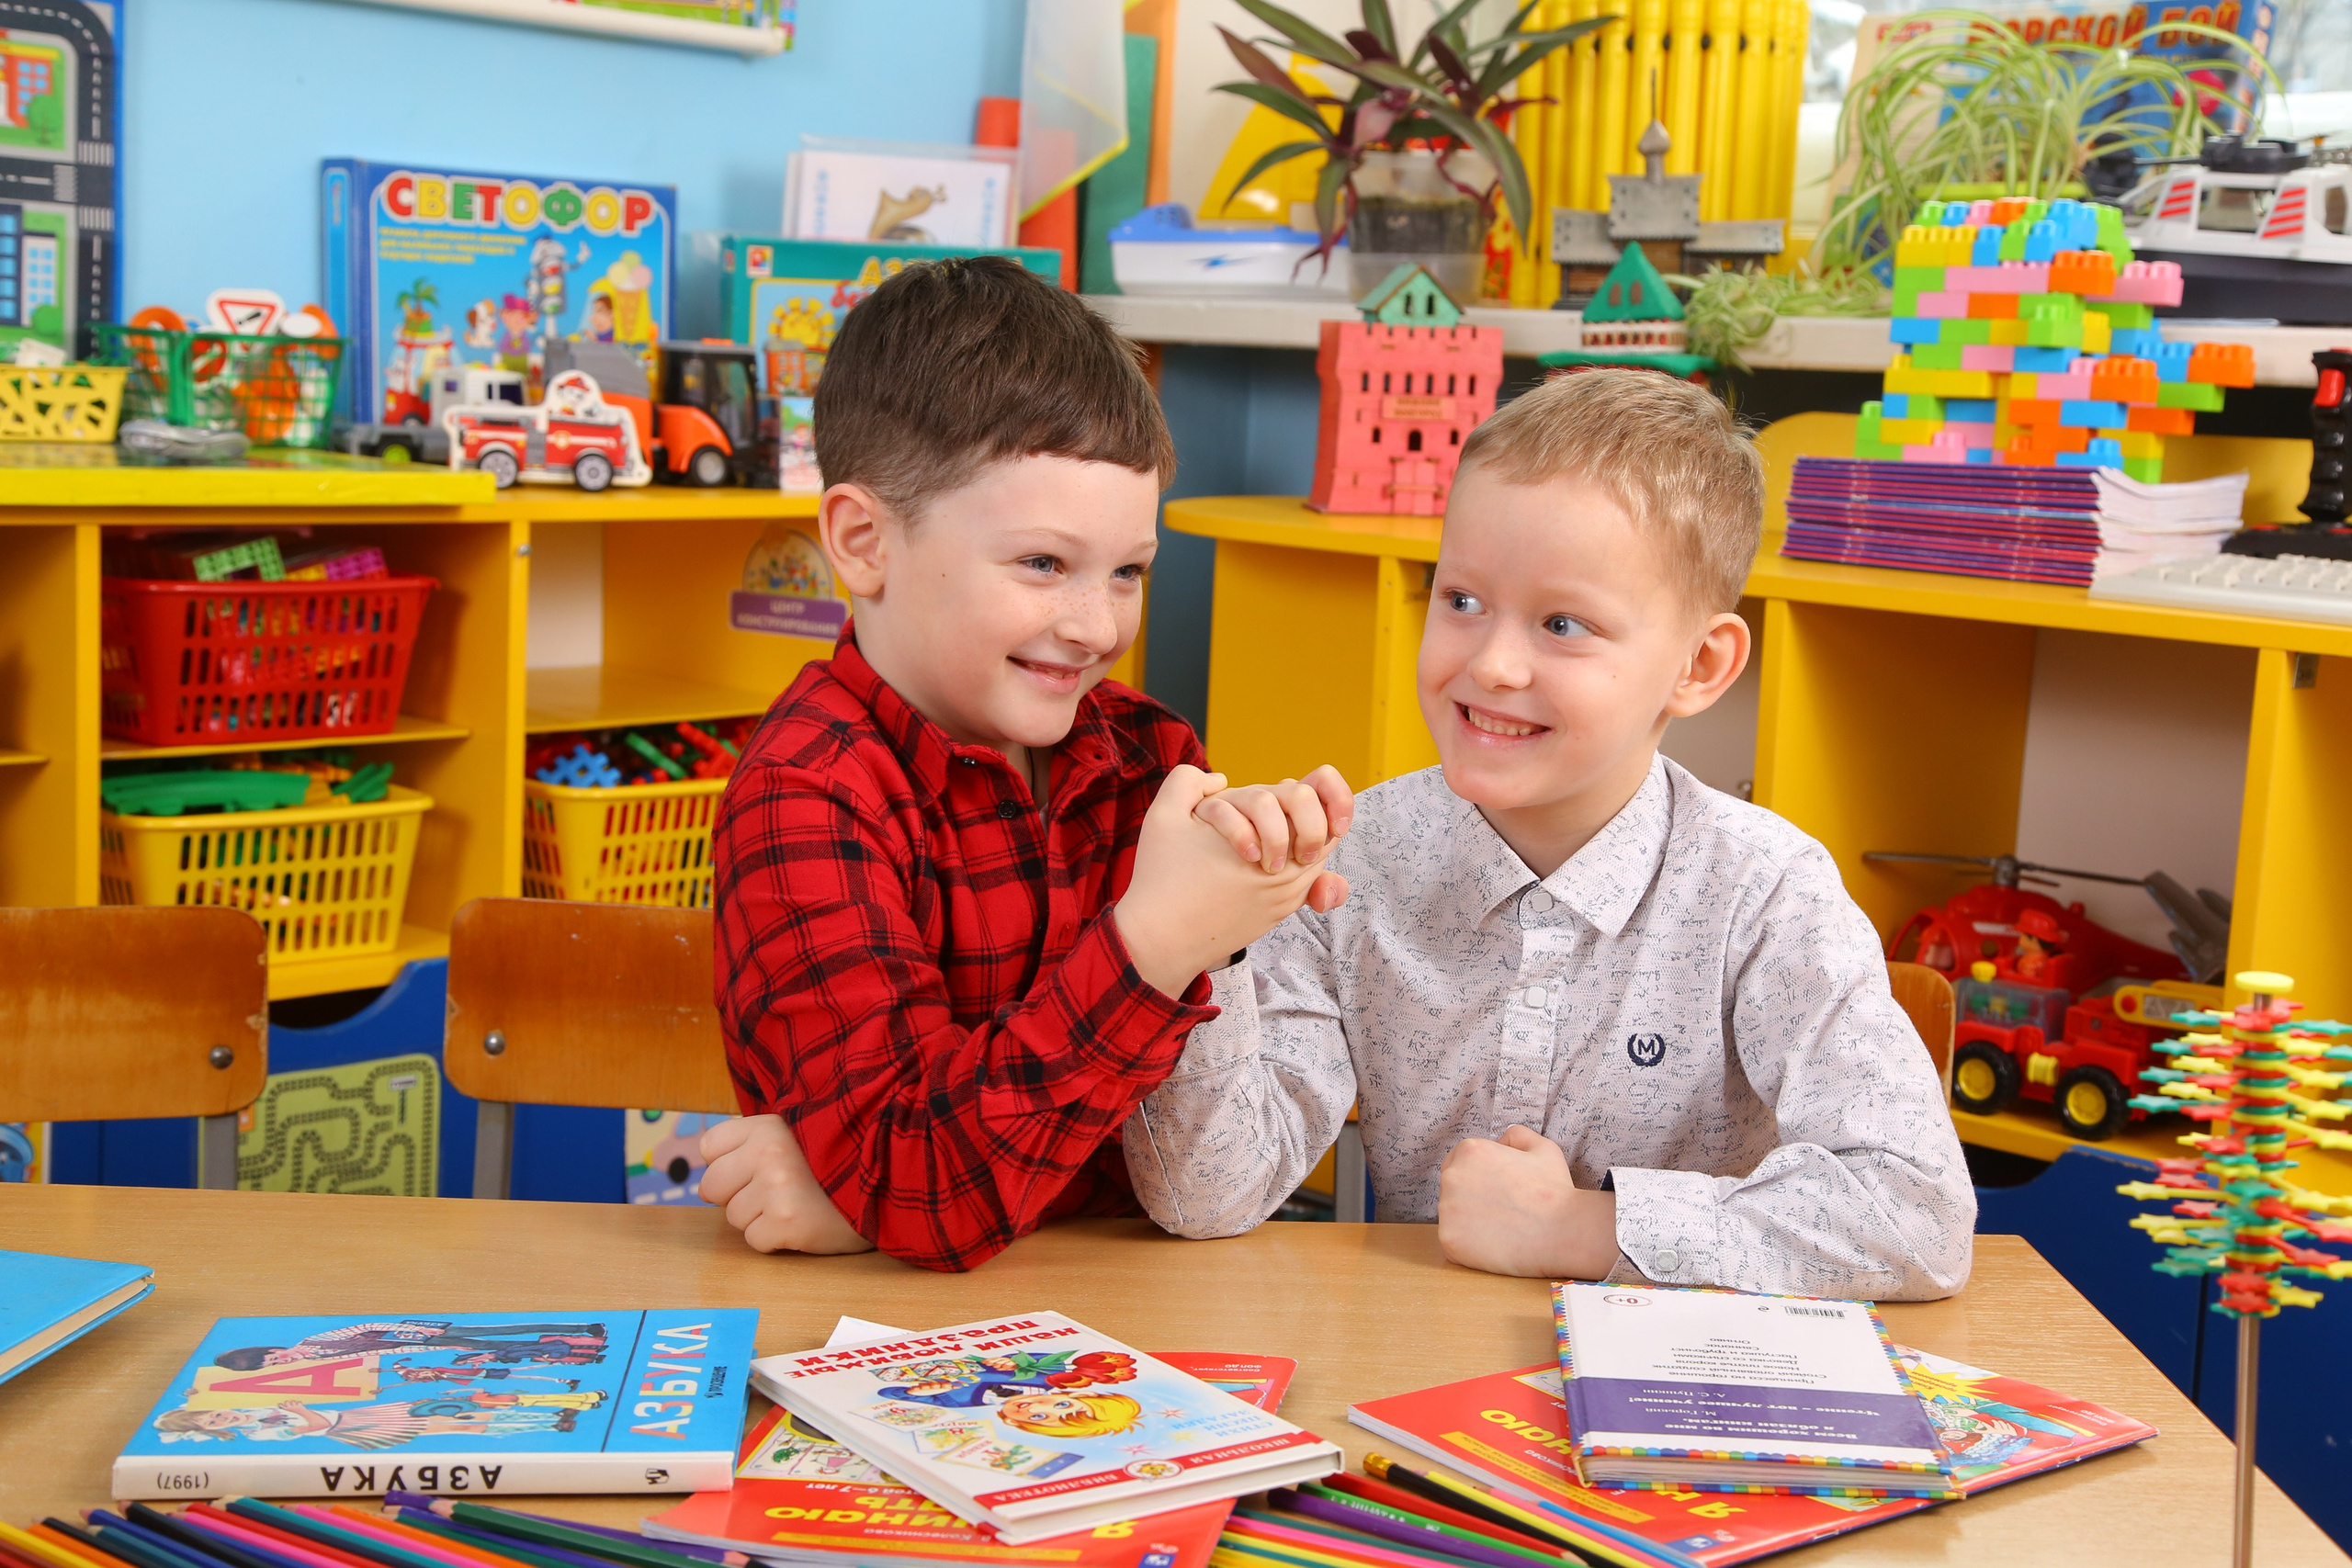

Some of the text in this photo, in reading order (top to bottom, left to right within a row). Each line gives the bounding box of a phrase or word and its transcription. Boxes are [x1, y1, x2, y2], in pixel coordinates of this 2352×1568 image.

[2156, 0, 2242, 48] БОЙ
[384, 175, 654, 233] СВЕТОФОР
[1615, 1296, 1639, 1307] 0+
[1670, 1347, 1726, 1355] трубочист
[1703, 1343, 1760, 1351] Свинопас
[1740, 1351, 1798, 1359] Пастушка
[1709, 1367, 1774, 1375] оловянный
[1778, 1371, 1827, 1380] Стойкий
[628, 1322, 712, 1439] АЗБУКА
[1748, 1375, 1815, 1384] Принцесса
[1628, 1396, 1693, 1405] учение!
[1698, 1399, 1762, 1409] лучшее
[1645, 1407, 1698, 1416] Горький
[1815, 1406, 1881, 1416] Чтение
[1171, 1409, 1251, 1430] ЗАГАДКИ
[1204, 1415, 1261, 1432] ПЕСНИ
[1682, 1417, 1752, 1427] книгам.
[1216, 1421, 1274, 1438] СТИХИ
[1757, 1421, 1819, 1430] обязан
[1727, 1426, 1809, 1436] хорошим
[1815, 1431, 1859, 1439] Всем
[992, 1438, 1291, 1504] ШКОЛЬНАЯ БИБЛИОТЕКА
[157, 1471, 209, 1490] (1997)
[320, 1465, 503, 1491] АЗБУКА
[806, 1482, 838, 1491] лет
[1686, 1501, 1748, 1518] Я
[864, 1527, 972, 1541] Колесникова
[1091, 1520, 1139, 1539] Я
